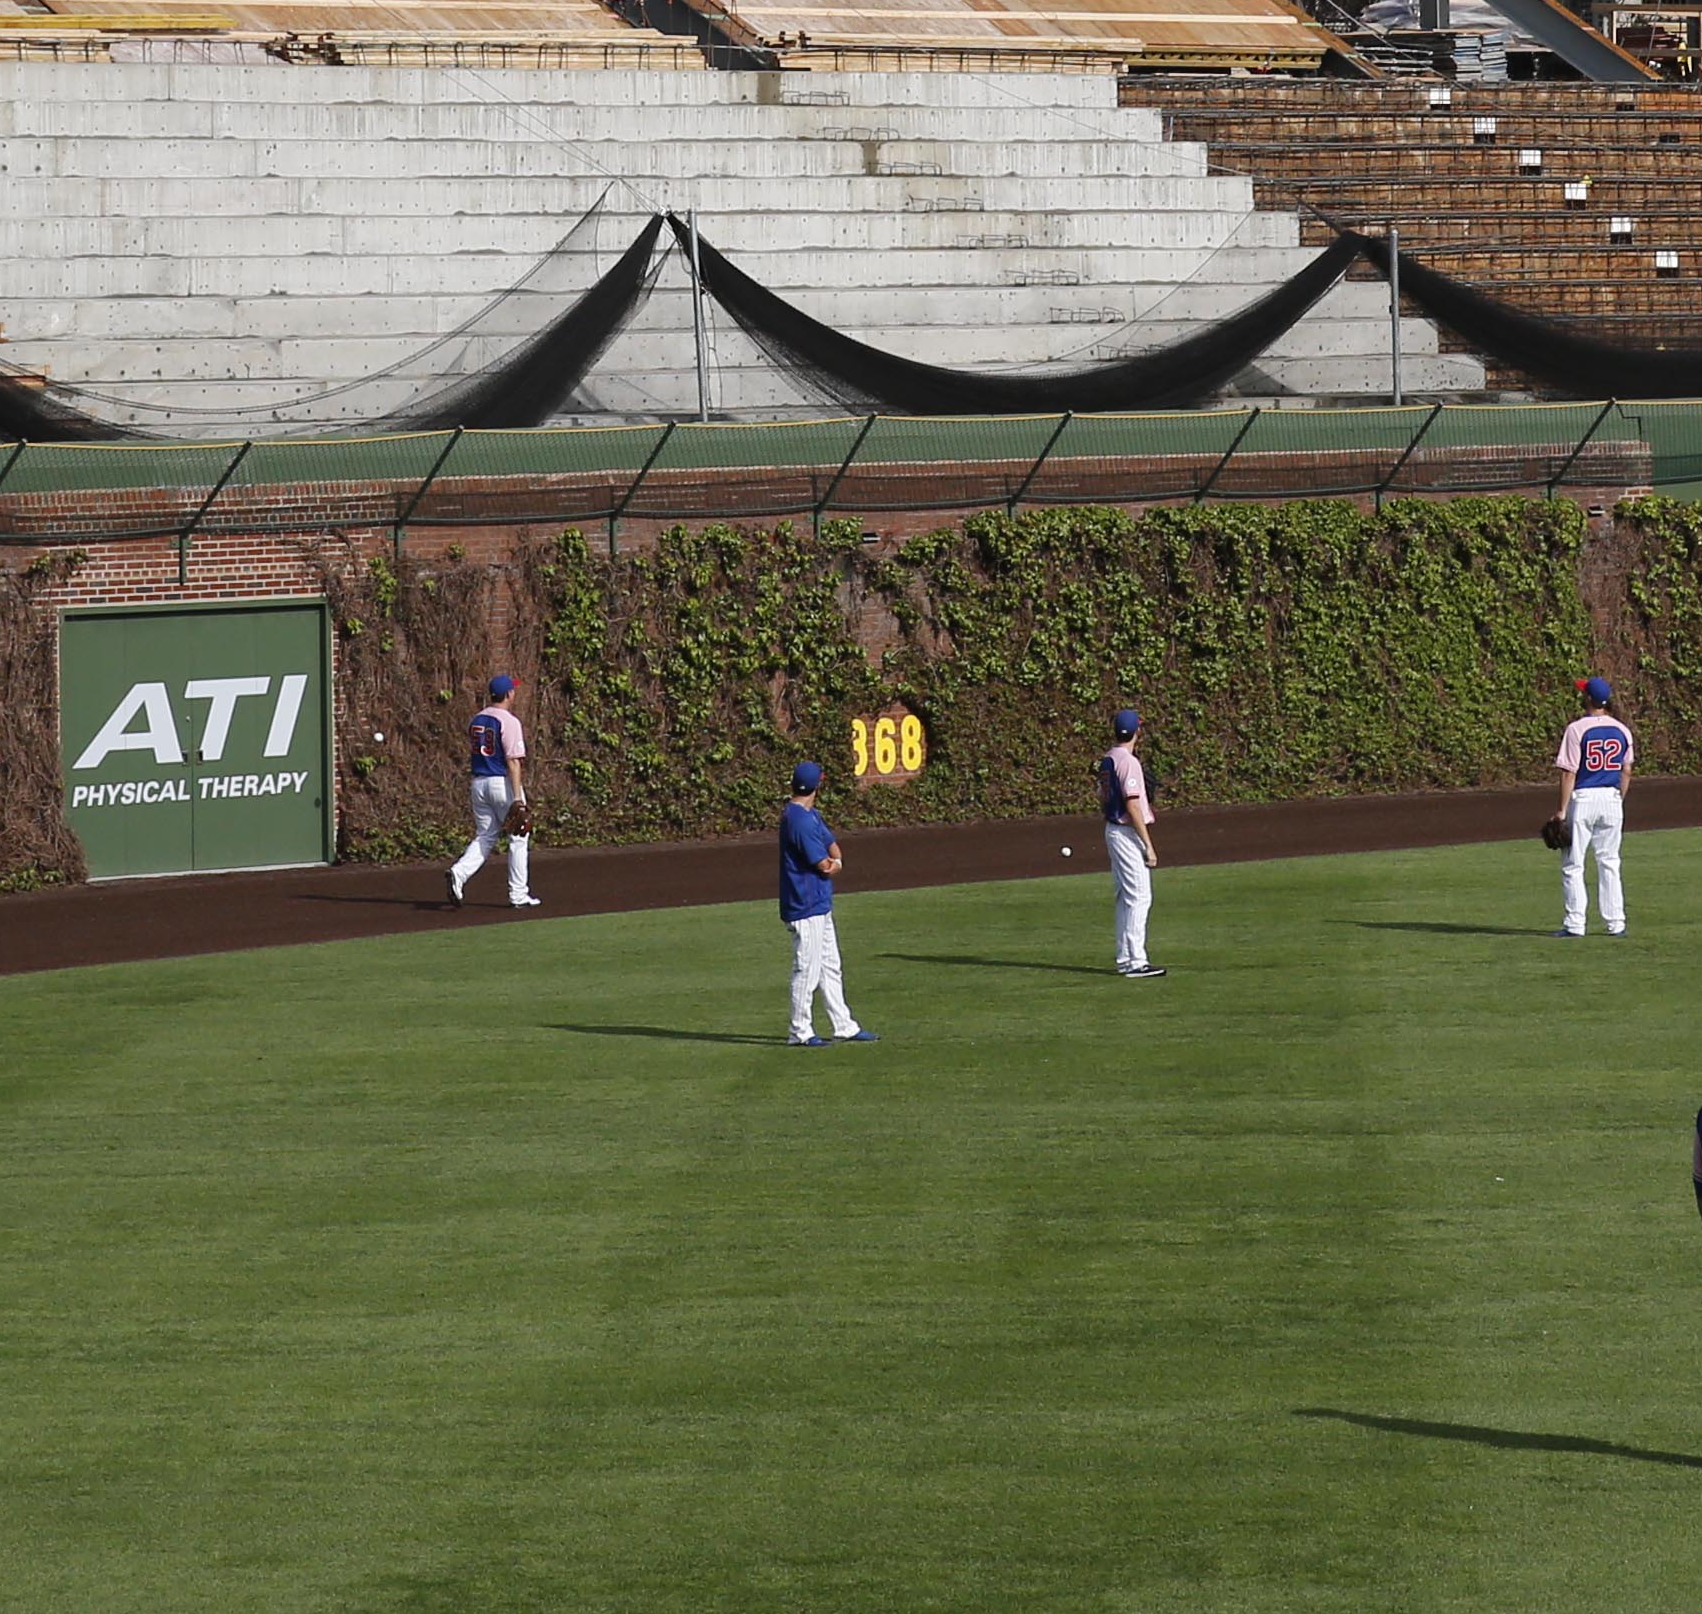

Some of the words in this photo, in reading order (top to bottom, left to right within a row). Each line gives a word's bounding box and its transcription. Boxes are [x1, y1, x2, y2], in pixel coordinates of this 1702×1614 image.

[72, 674, 309, 770] ATI
[851, 714, 922, 776] 368
[1585, 738, 1622, 772] 52
[71, 780, 190, 809] PHYSICAL
[198, 771, 309, 800] THERAPY
